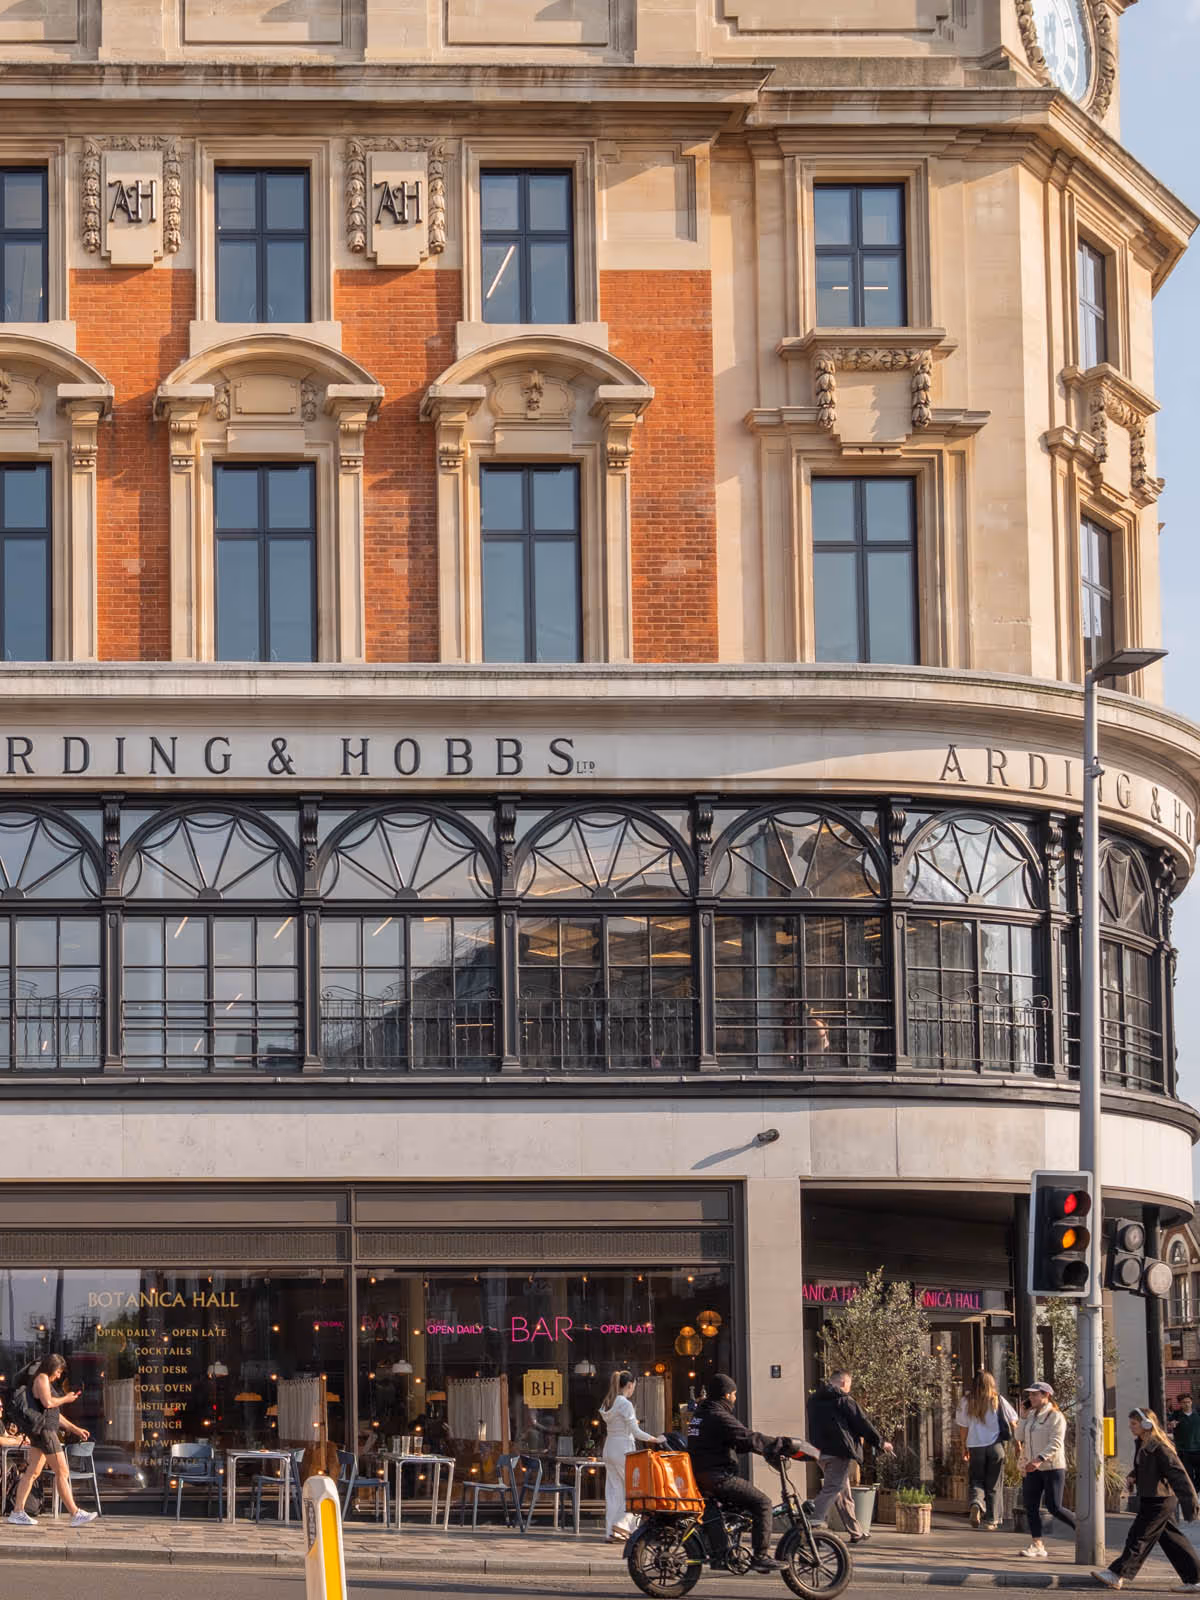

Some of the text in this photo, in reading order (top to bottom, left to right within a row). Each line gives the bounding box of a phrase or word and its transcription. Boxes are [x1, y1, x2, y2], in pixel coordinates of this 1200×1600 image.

[268, 736, 297, 775] &
[340, 737, 575, 776] HOBBS
[939, 744, 1132, 809] ARDIG
[1151, 786, 1162, 824] &
[88, 1291, 239, 1307] BOTANICA HALL
[955, 1291, 981, 1310] HALL
[97, 1328, 124, 1337] OPEN
[126, 1328, 156, 1337] DAILY
[172, 1328, 198, 1337] OPEN
[201, 1328, 227, 1337] LATE
[426, 1316, 655, 1342] OPEN DAILY BAR OPEN LATE
[134, 1347, 192, 1355] COCKTAILS
[138, 1366, 188, 1374] HOT DESK
[134, 1384, 192, 1392] COAL OVEN
[532, 1381, 554, 1396] BH
[136, 1402, 188, 1411] DISTILLERY
[142, 1421, 182, 1429] BRUNCH
